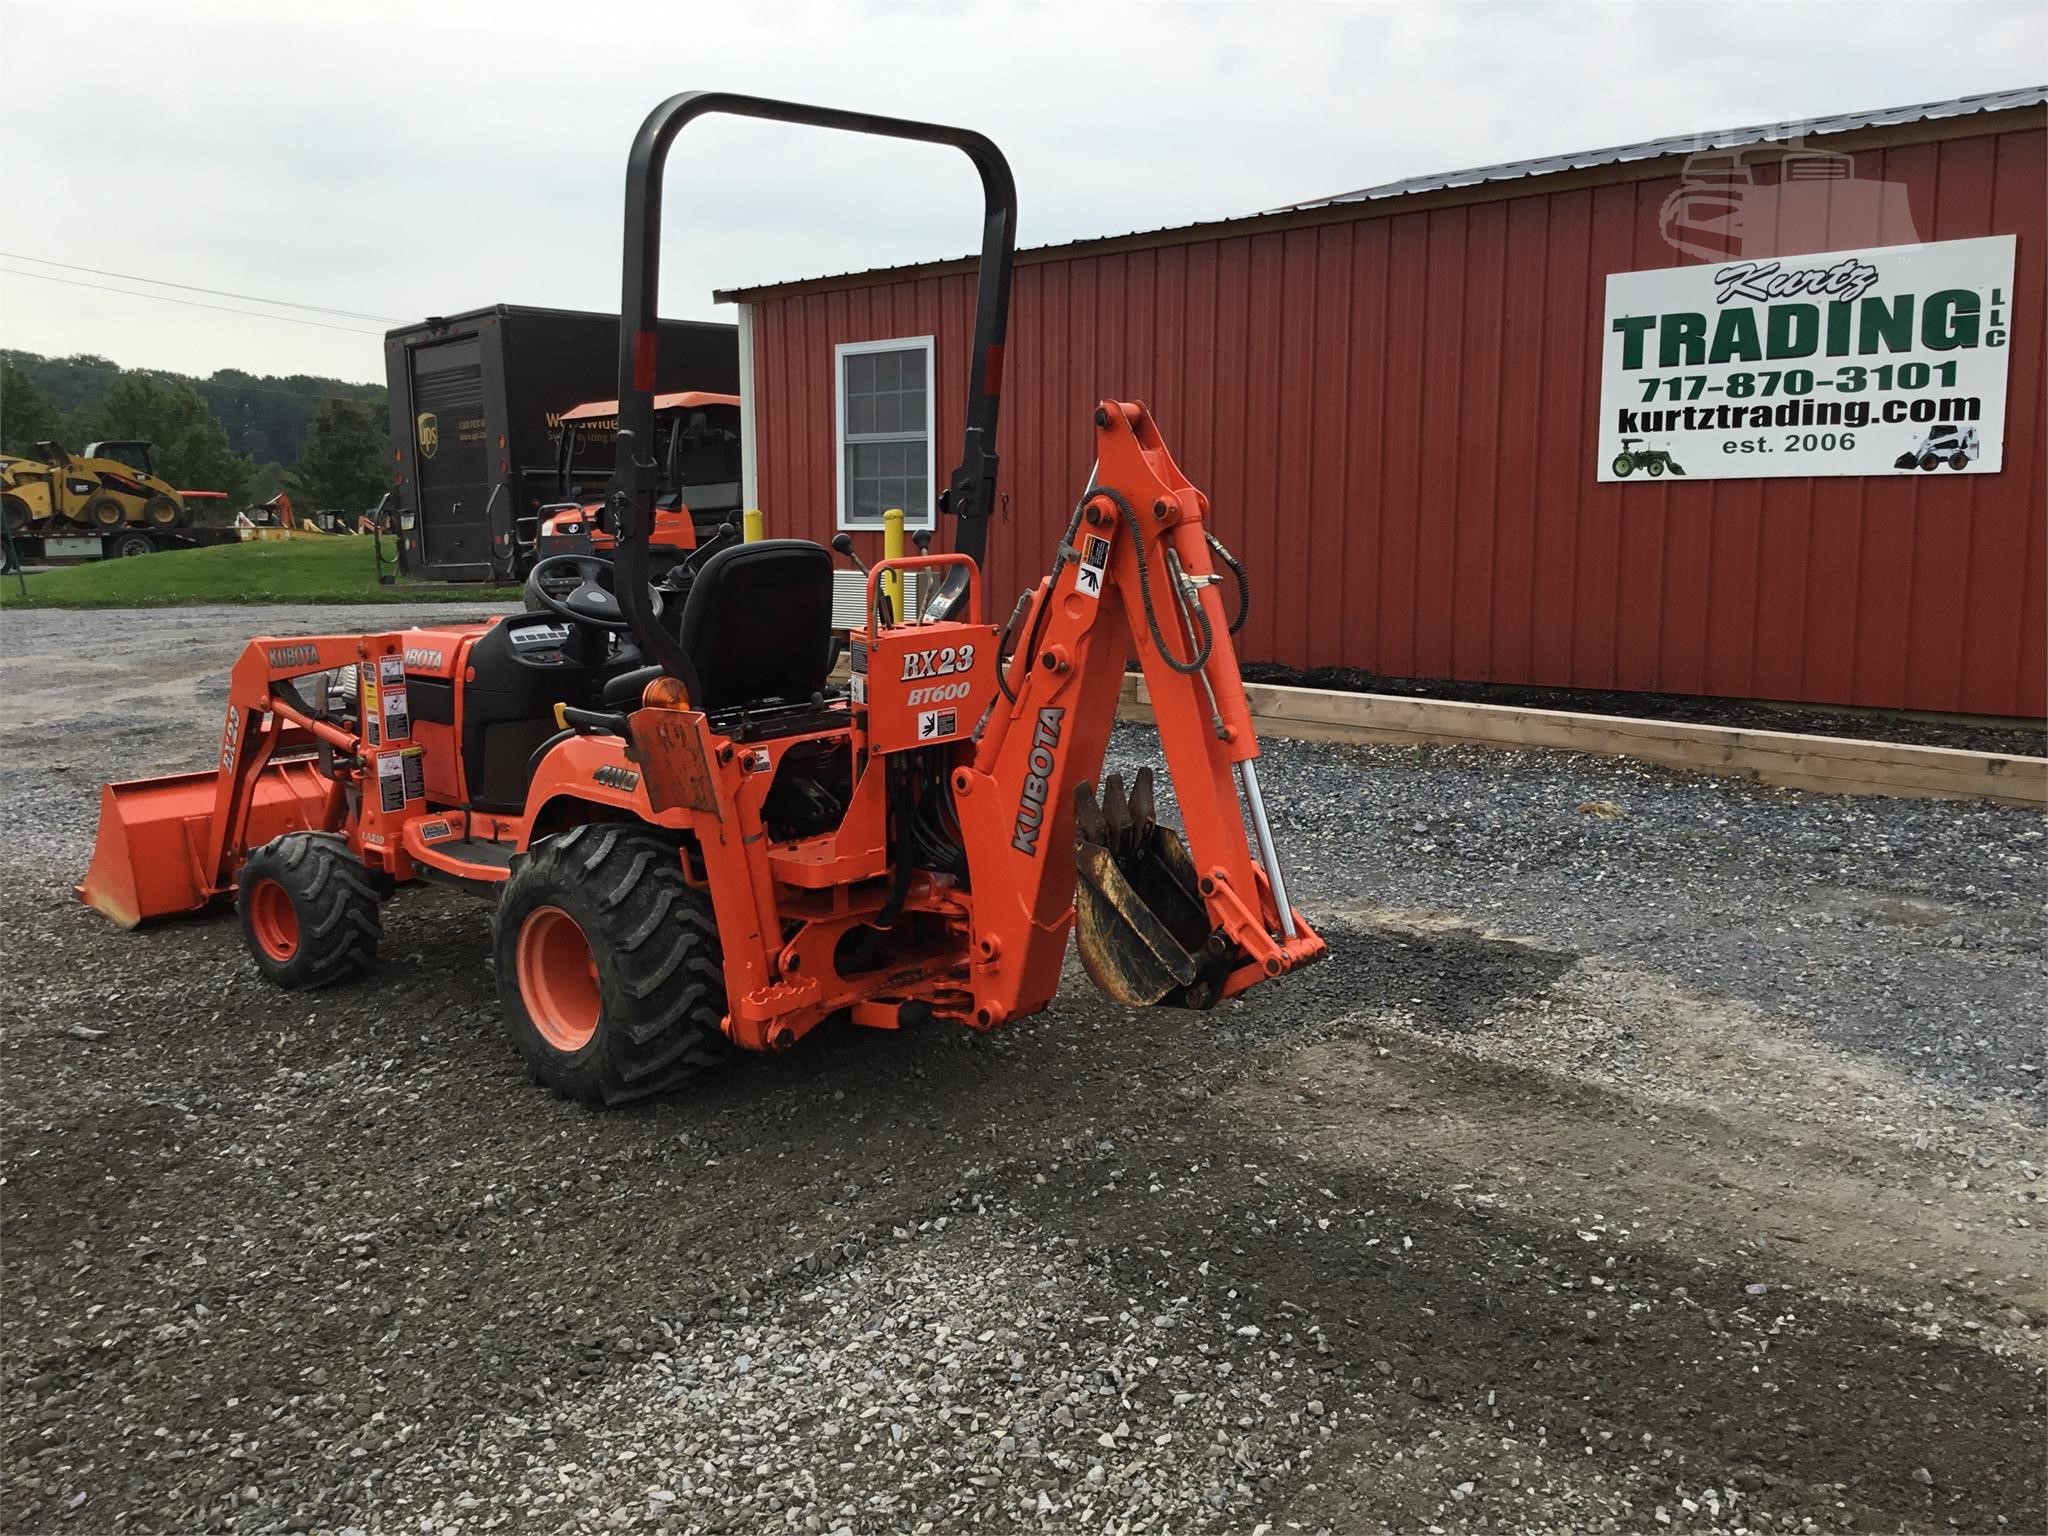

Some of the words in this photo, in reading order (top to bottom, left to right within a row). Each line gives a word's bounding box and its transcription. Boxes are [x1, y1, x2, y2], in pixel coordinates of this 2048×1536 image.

[1714, 258, 1879, 304] Kurtz
[1613, 289, 1981, 371] TRADING
[1638, 360, 1957, 403] 717-870-3101
[546, 412, 618, 430] Wwide
[1618, 396, 1981, 434] kurtztrading.com
[420, 427, 438, 452] ups
[1722, 434, 1774, 454] est.
[1784, 432, 1856, 453] 2006
[269, 644, 320, 669] KUBOTA
[403, 648, 443, 671] BOTA
[900, 644, 975, 683] BX23
[906, 681, 971, 707] BT600
[1011, 707, 1066, 857] KUBOTA
